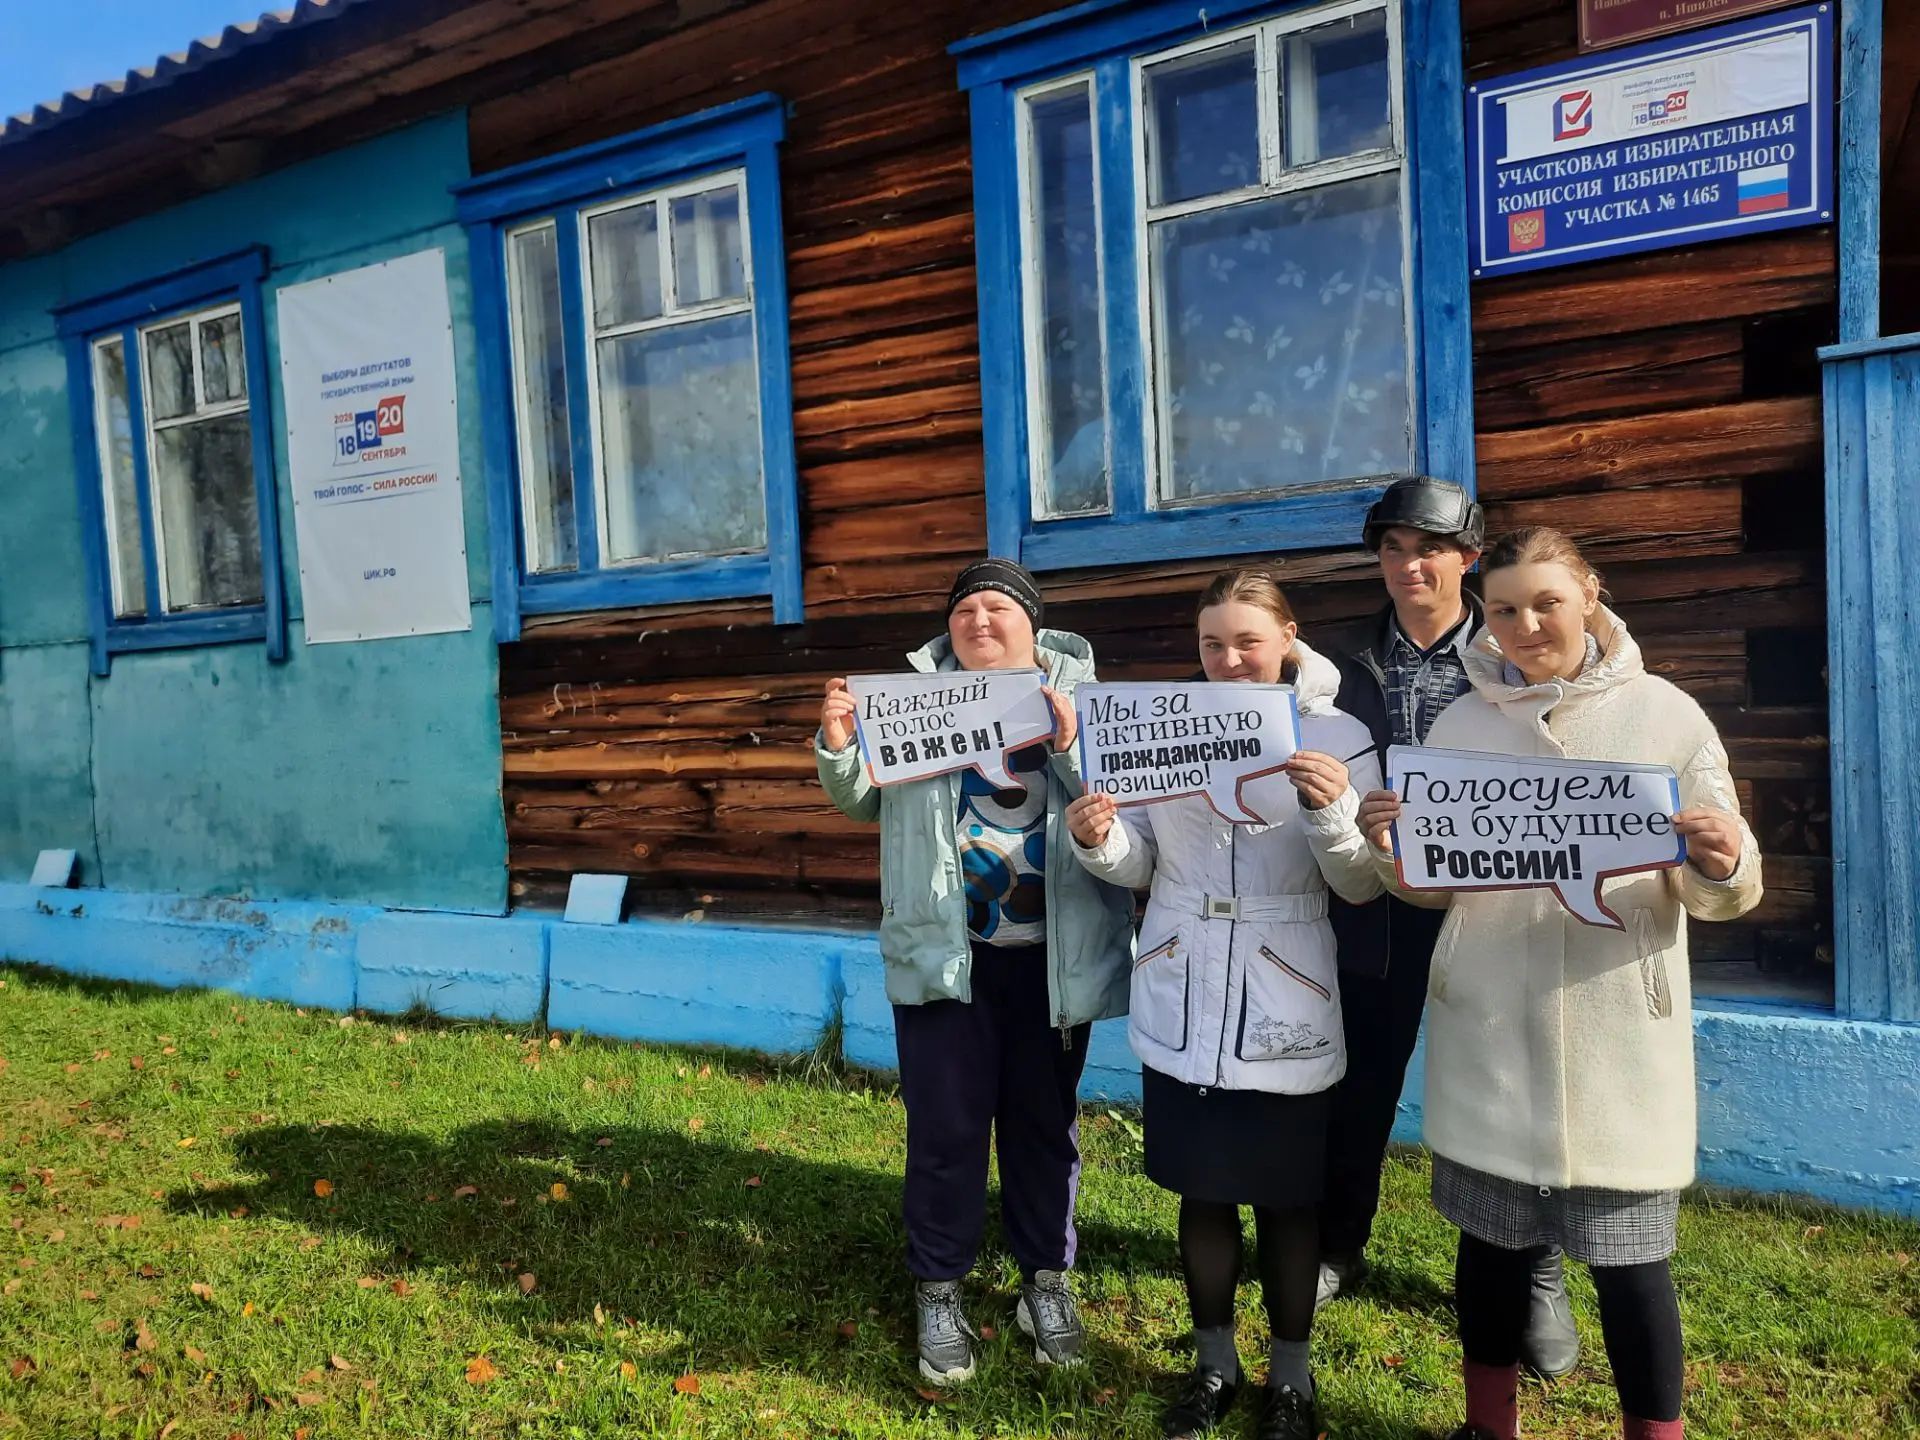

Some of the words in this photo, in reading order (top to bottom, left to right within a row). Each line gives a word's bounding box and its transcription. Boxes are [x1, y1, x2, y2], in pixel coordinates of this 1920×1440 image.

[1634, 114, 1647, 125] 18
[1650, 105, 1664, 116] 19
[1667, 96, 1685, 108] 20
[1498, 150, 1618, 189] УЧАСТКОВАЯ
[1624, 114, 1795, 165] ИЗБИРАТЕЛЬНАЯ
[1497, 179, 1602, 215] КОМИССИЯ
[1614, 143, 1795, 193] ИЗБИРАТЕЛЬНОГО
[1565, 199, 1649, 229] УЧАСТКА
[1657, 192, 1676, 211] №
[1683, 184, 1720, 206] 1465
[322, 368, 358, 384] ВЫБОРЫ
[360, 358, 411, 376] ДЕПУТАТОВ
[391, 376, 414, 387] ДУМЫ
[339, 436, 355, 456] 18
[357, 420, 376, 441] 19
[379, 405, 401, 428] 20
[362, 446, 406, 461] СЕНТЯБРЯ
[314, 486, 335, 499] ТВОЙ
[337, 484, 364, 496] ГОЛОС
[373, 479, 397, 491] СИЛА
[399, 472, 438, 487] РОССИИ!
[363, 568, 396, 580] ЦИК.РФ
[864, 676, 990, 721] Каждый
[1088, 694, 1140, 726] Мы
[1151, 692, 1191, 717] за
[878, 711, 956, 739] голос
[1096, 709, 1263, 748] активную
[879, 721, 1005, 767] важен!
[1101, 737, 1261, 774] гражданскую
[1094, 763, 1212, 795] позицию!
[1400, 771, 1635, 812] Голосуем
[1414, 815, 1458, 837] за
[1471, 804, 1670, 845] будущее
[1424, 844, 1582, 880] России!
